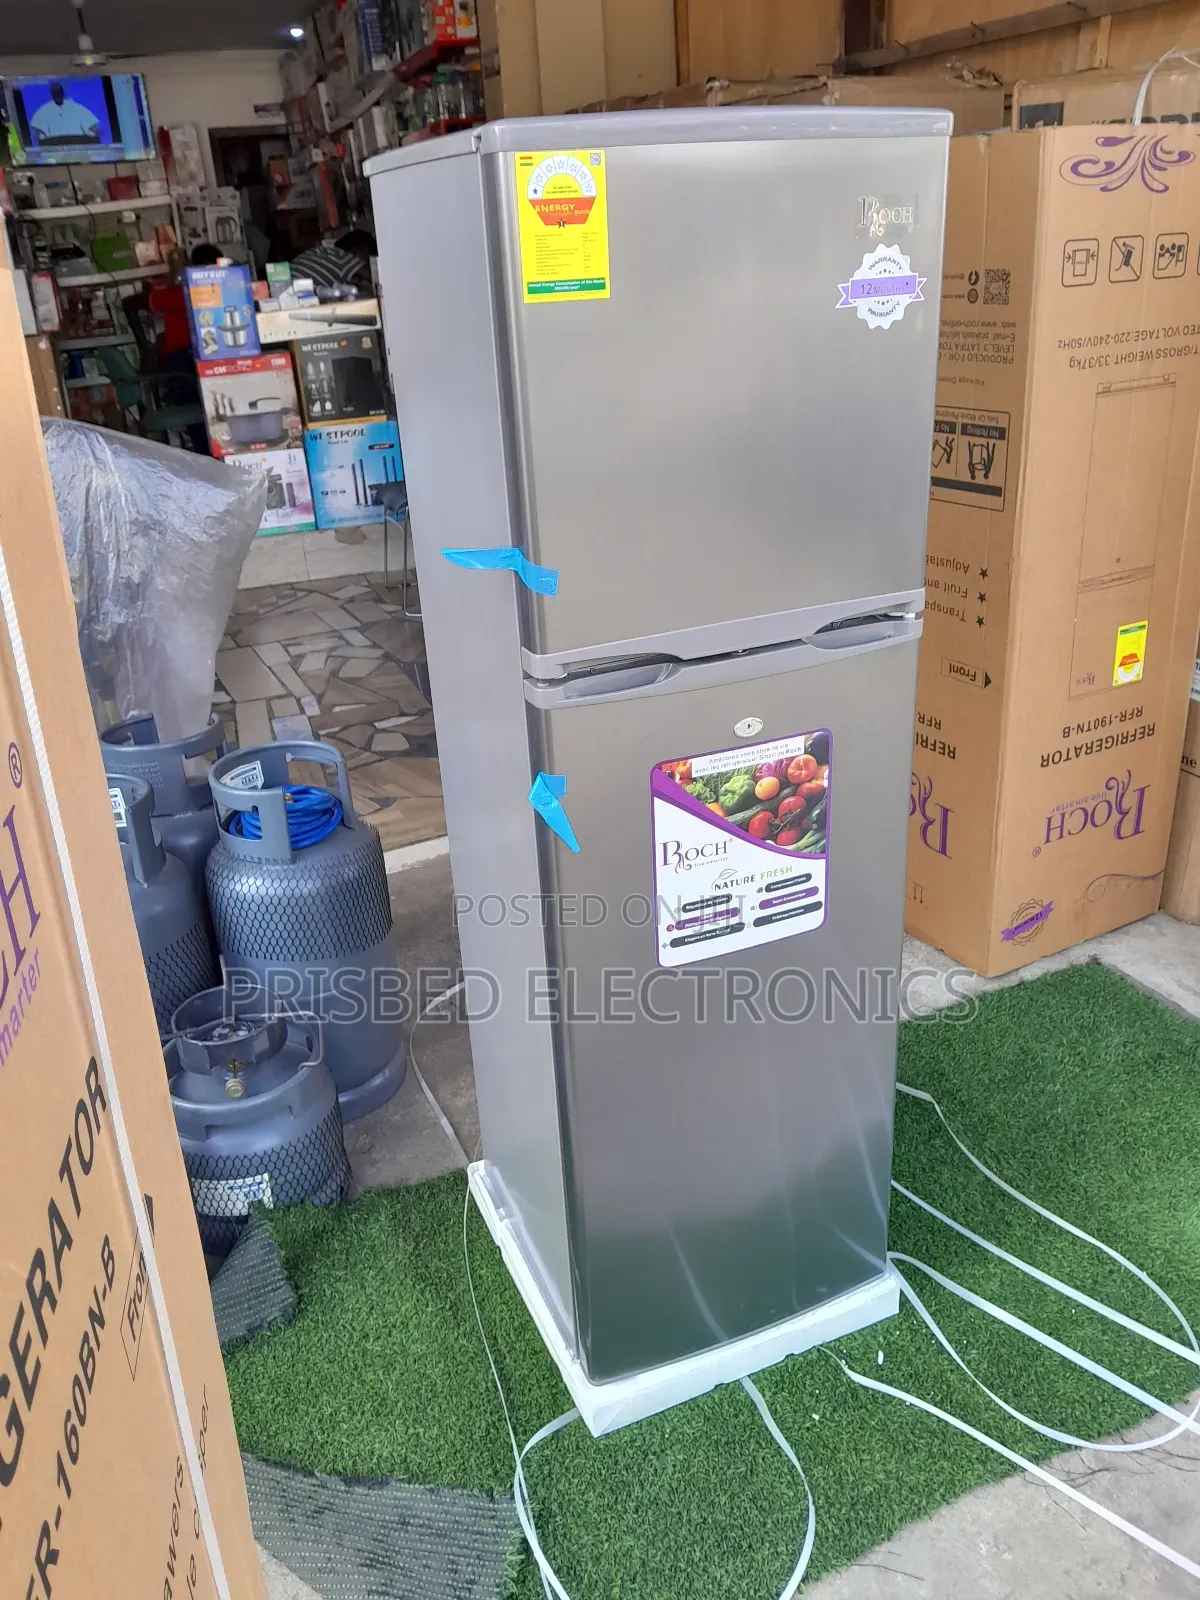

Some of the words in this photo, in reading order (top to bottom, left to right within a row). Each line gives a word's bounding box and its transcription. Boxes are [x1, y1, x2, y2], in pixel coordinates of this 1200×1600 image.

[534, 203, 575, 213] ENERGY
[867, 255, 903, 271] WARRANTY
[990, 343, 1015, 353] LEVEL
[988, 430, 1000, 438] No
[943, 581, 968, 599] Fruit
[948, 662, 977, 682] Front
[1062, 705, 1144, 738] RFR-190TN-B
[1040, 722, 1156, 768] REFRIGERATOR
[713, 874, 756, 891] NATURE
[760, 864, 793, 881] FRESH
[127, 1250, 149, 1344] Fron
